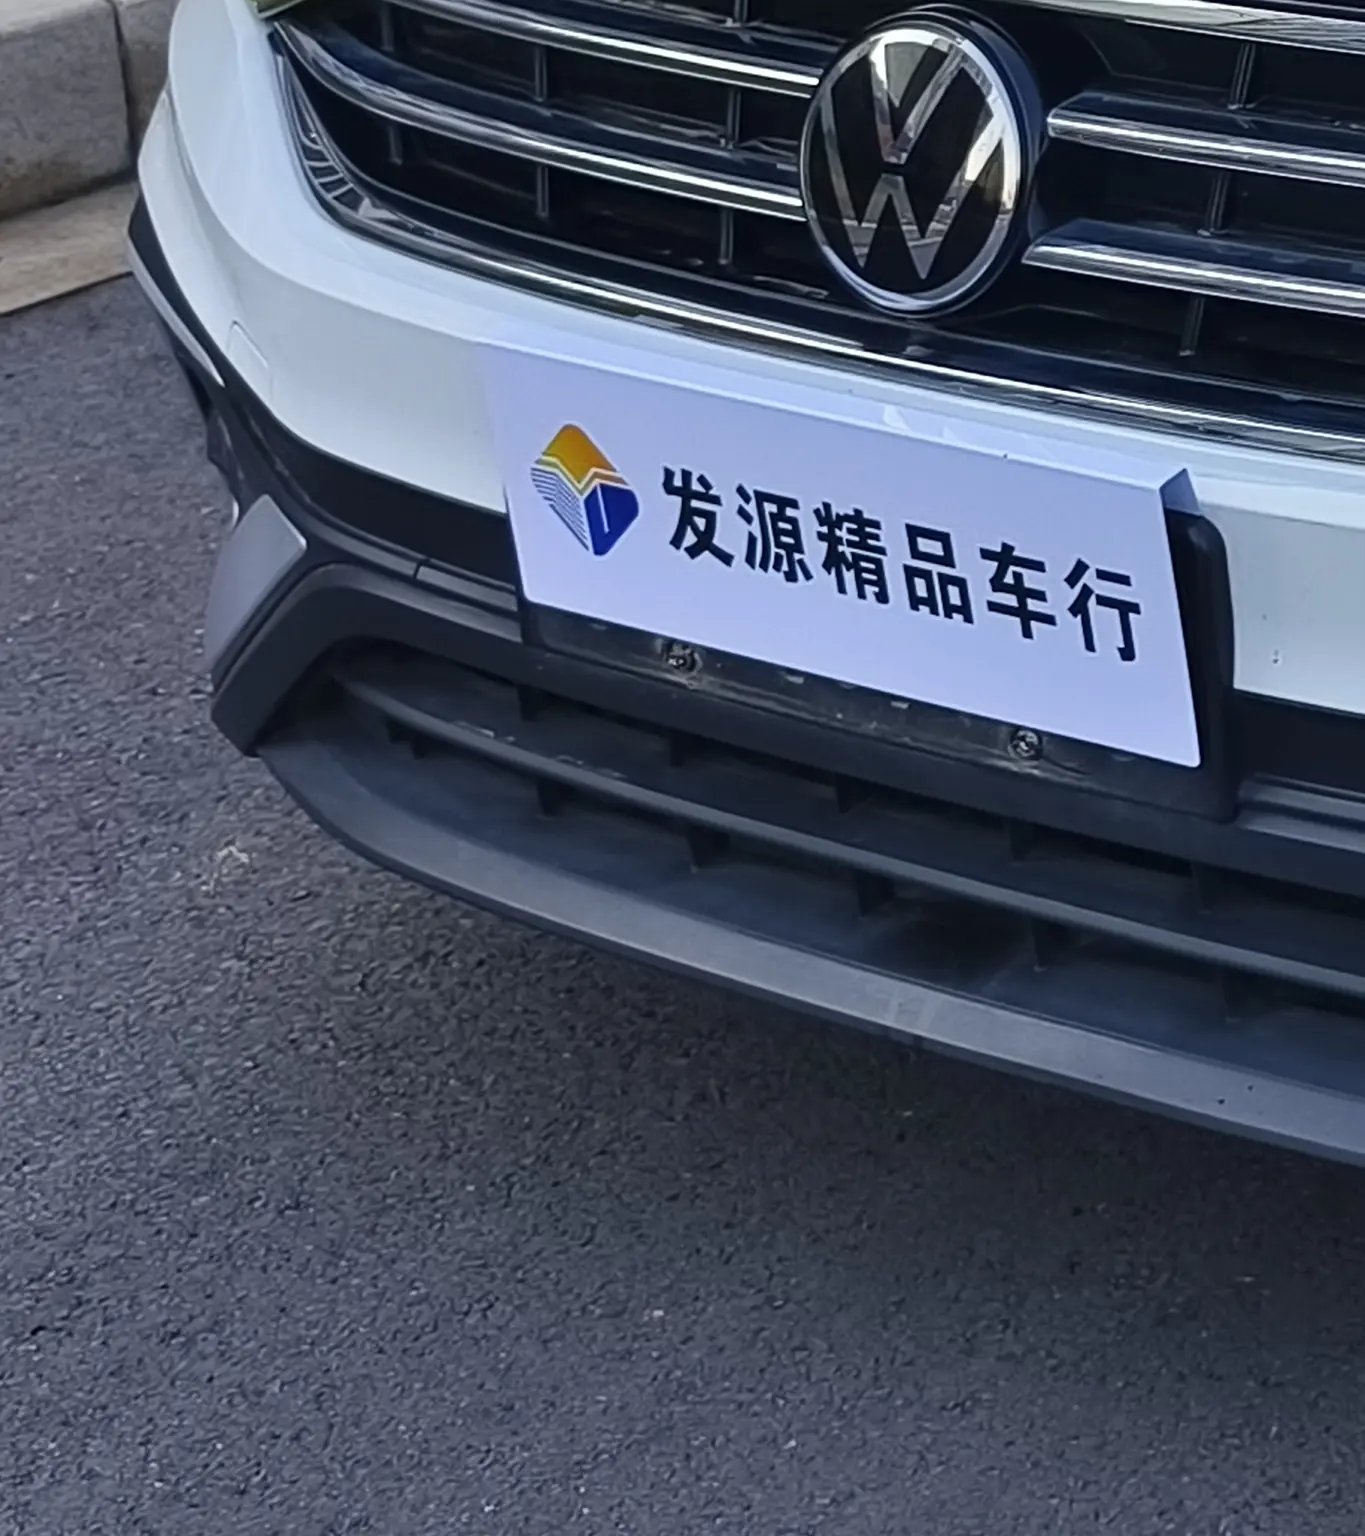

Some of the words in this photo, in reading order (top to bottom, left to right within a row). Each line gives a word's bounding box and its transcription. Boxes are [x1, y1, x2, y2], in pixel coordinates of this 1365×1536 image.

[661, 466, 1142, 663] 发源精品车行
